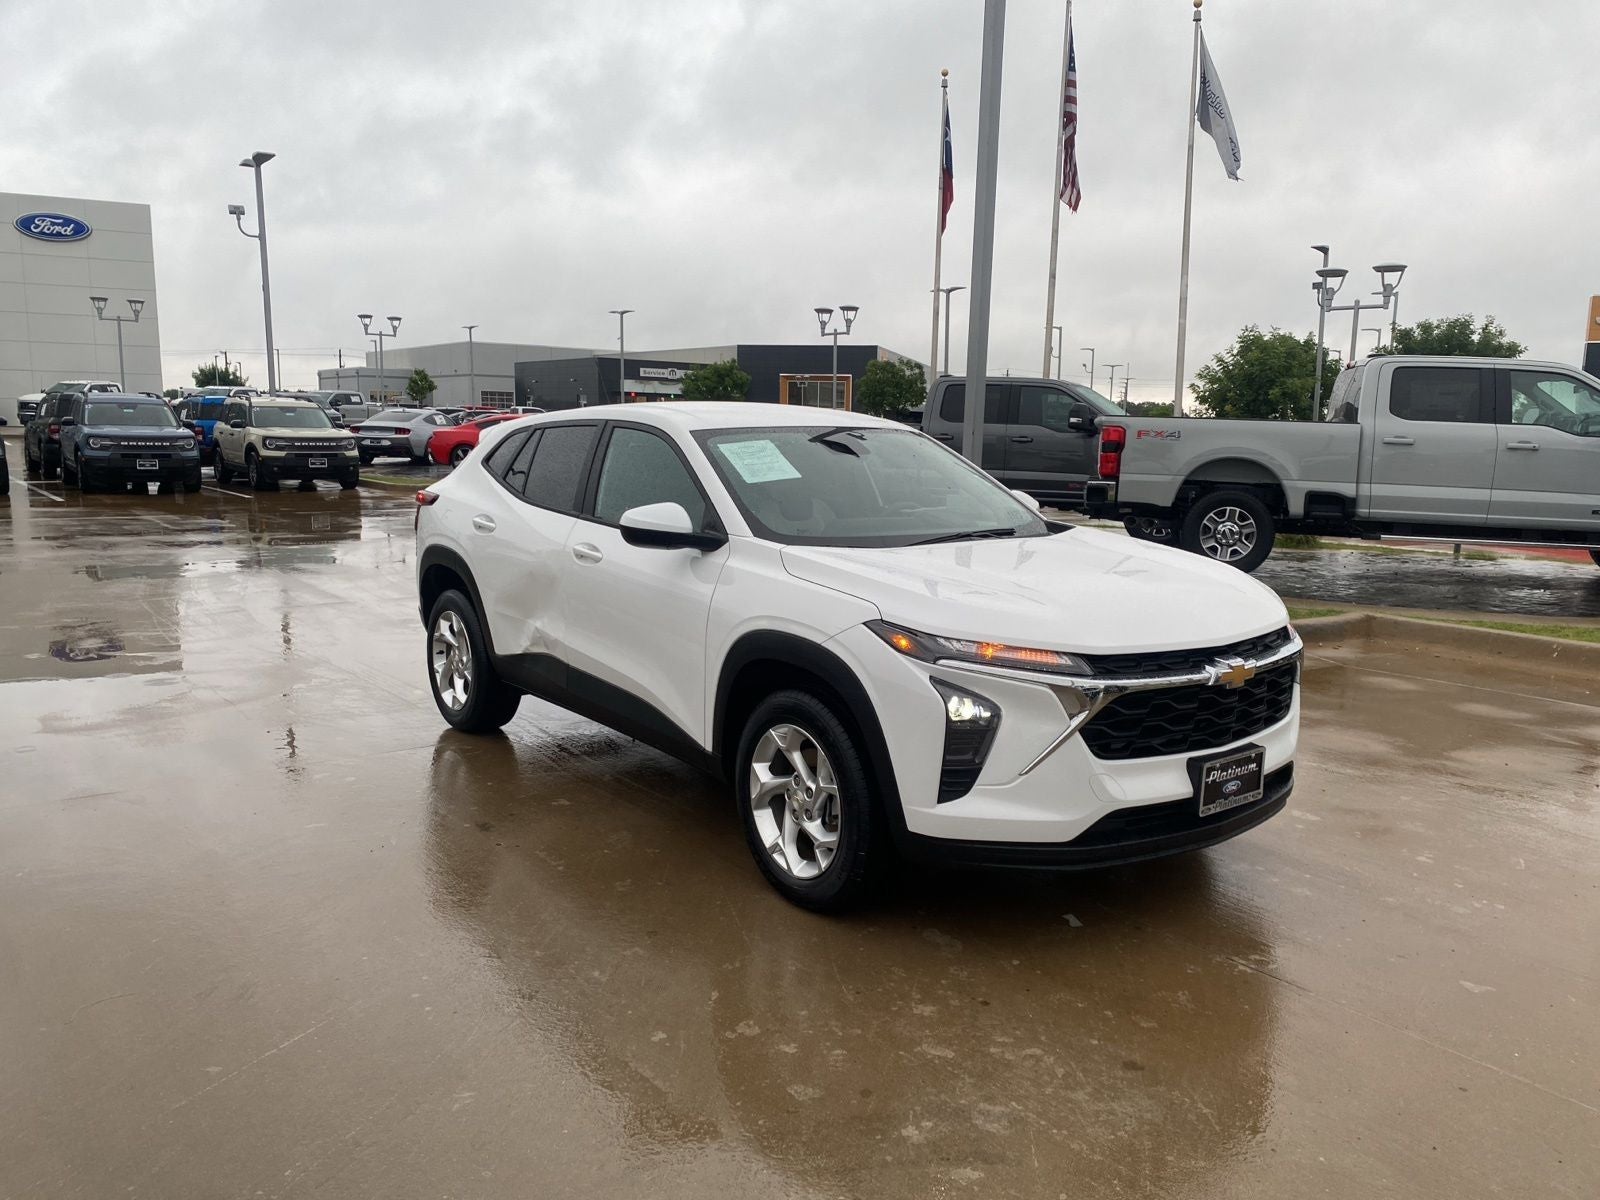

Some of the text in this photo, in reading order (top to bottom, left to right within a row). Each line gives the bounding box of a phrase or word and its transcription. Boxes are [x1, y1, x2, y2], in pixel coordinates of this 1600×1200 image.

[30, 217, 74, 235] Ford
[1136, 429, 1181, 439] FX4
[1205, 762, 1259, 784] Platinum
